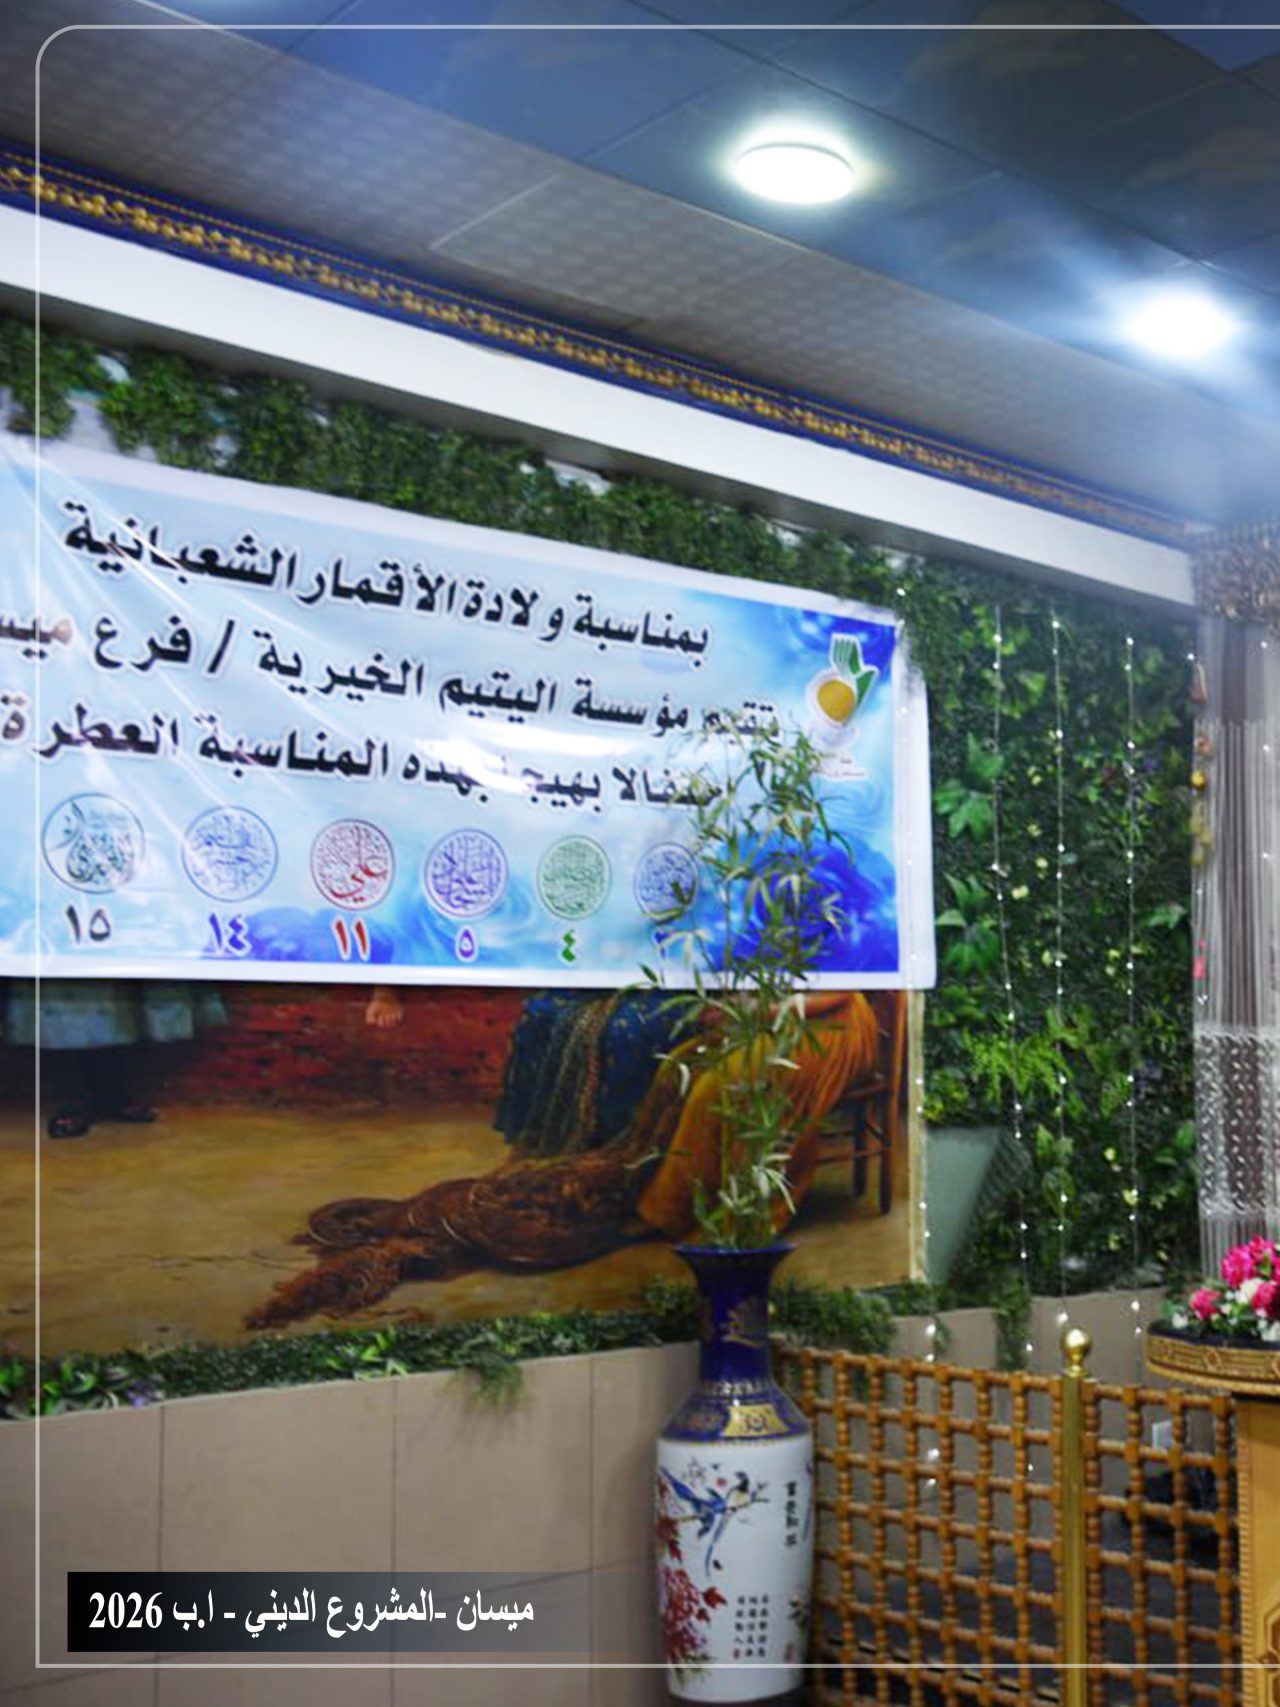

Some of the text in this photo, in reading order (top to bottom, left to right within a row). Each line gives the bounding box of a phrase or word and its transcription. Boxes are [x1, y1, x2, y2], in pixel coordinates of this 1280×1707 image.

[64, 501, 709, 668] بمناسبة ولادة الأقمار الشعبانية
[94, 615, 192, 671] فرع
[207, 619, 236, 675] /
[252, 630, 425, 703] الخيرية
[438, 670, 558, 726] اليتيم
[571, 677, 690, 738] مؤسسة
[1, 695, 180, 759] العطرة
[193, 712, 389, 779] المناسبة
[65, 904, 112, 943] ١٥
[208, 912, 250, 951] ١٤
[335, 919, 368, 956] ١١
[458, 928, 475, 958] ٥
[561, 928, 577, 962] ٤
